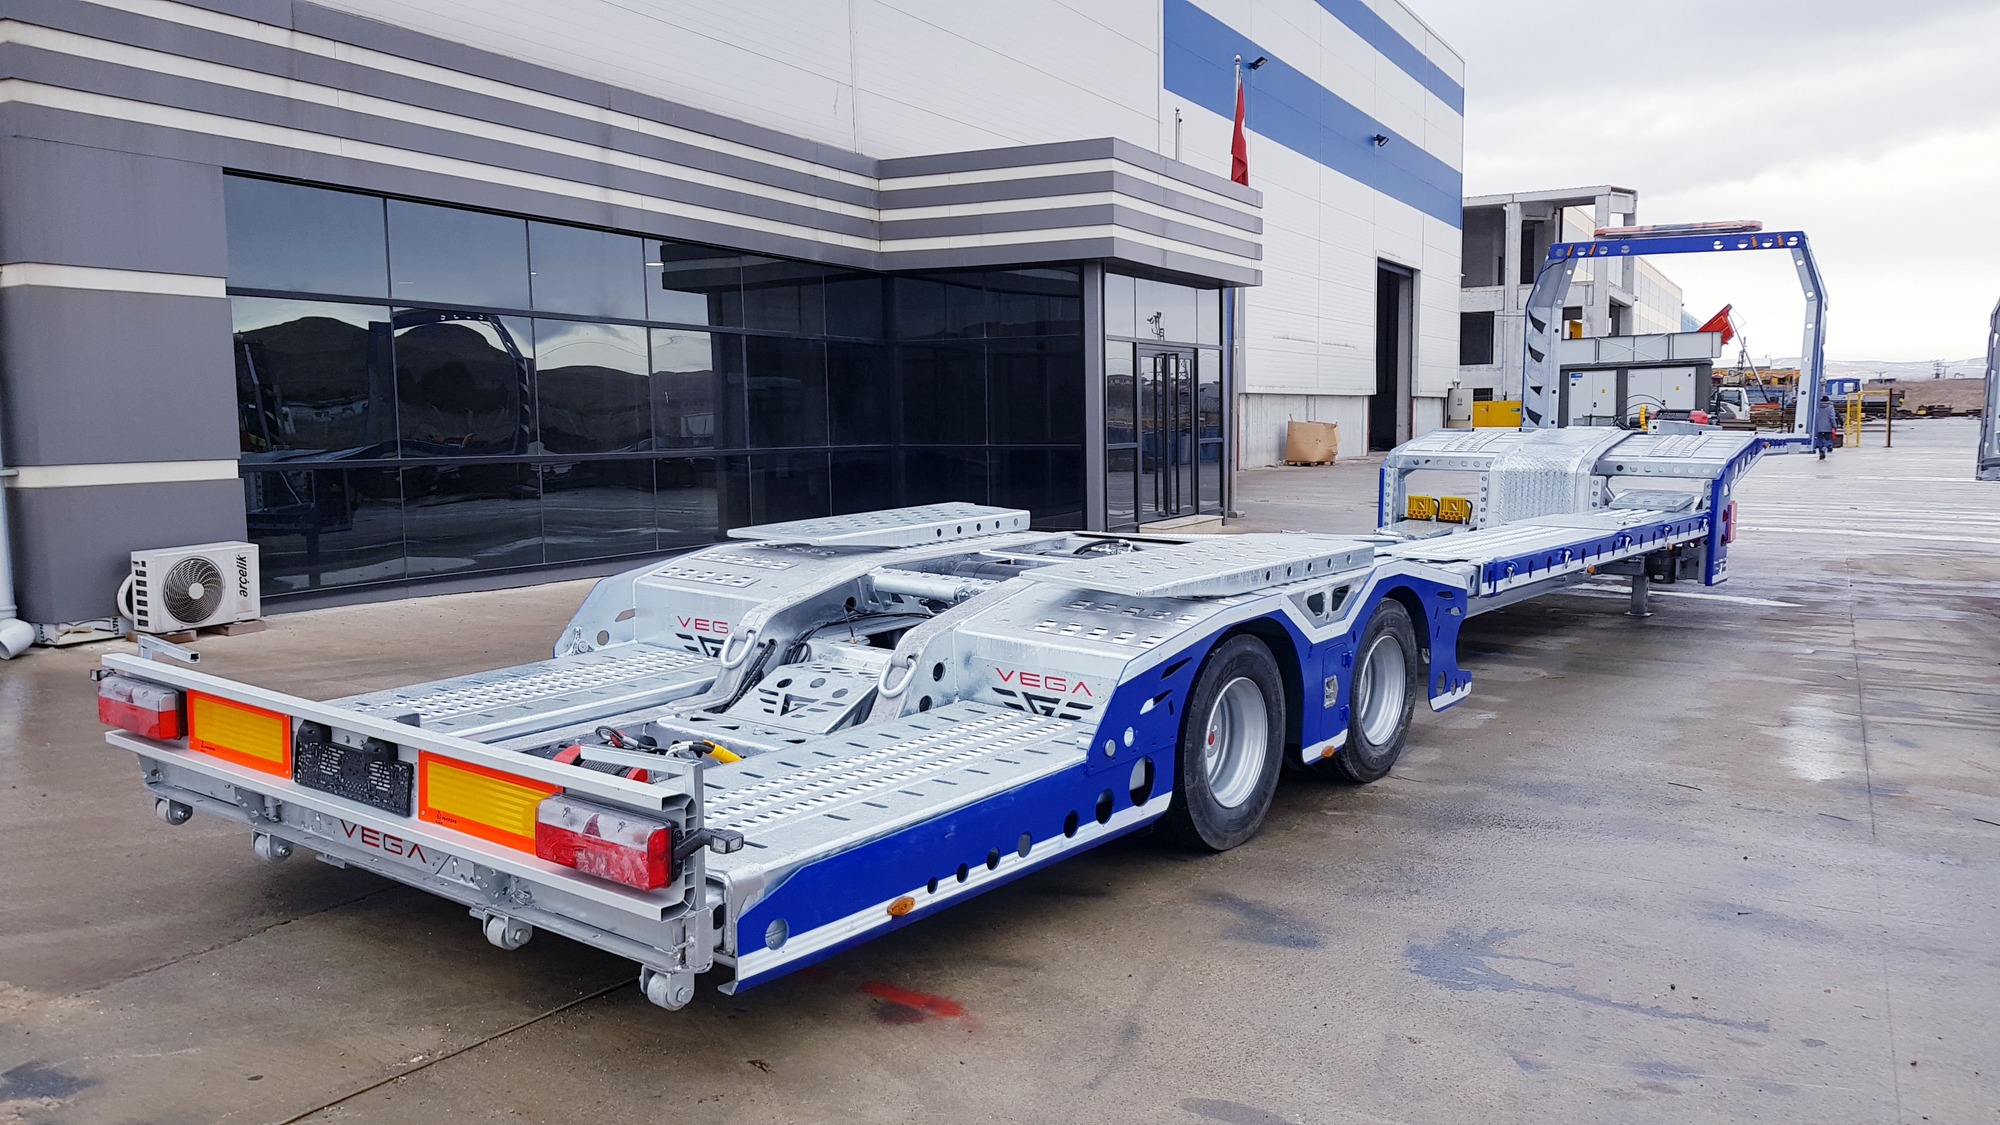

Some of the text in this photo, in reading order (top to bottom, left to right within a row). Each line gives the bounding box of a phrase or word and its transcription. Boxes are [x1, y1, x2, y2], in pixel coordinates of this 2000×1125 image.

[236, 554, 250, 598] arçelik
[677, 615, 729, 635] VEG
[995, 667, 1093, 697] VEGA
[340, 818, 427, 864] VEGA
